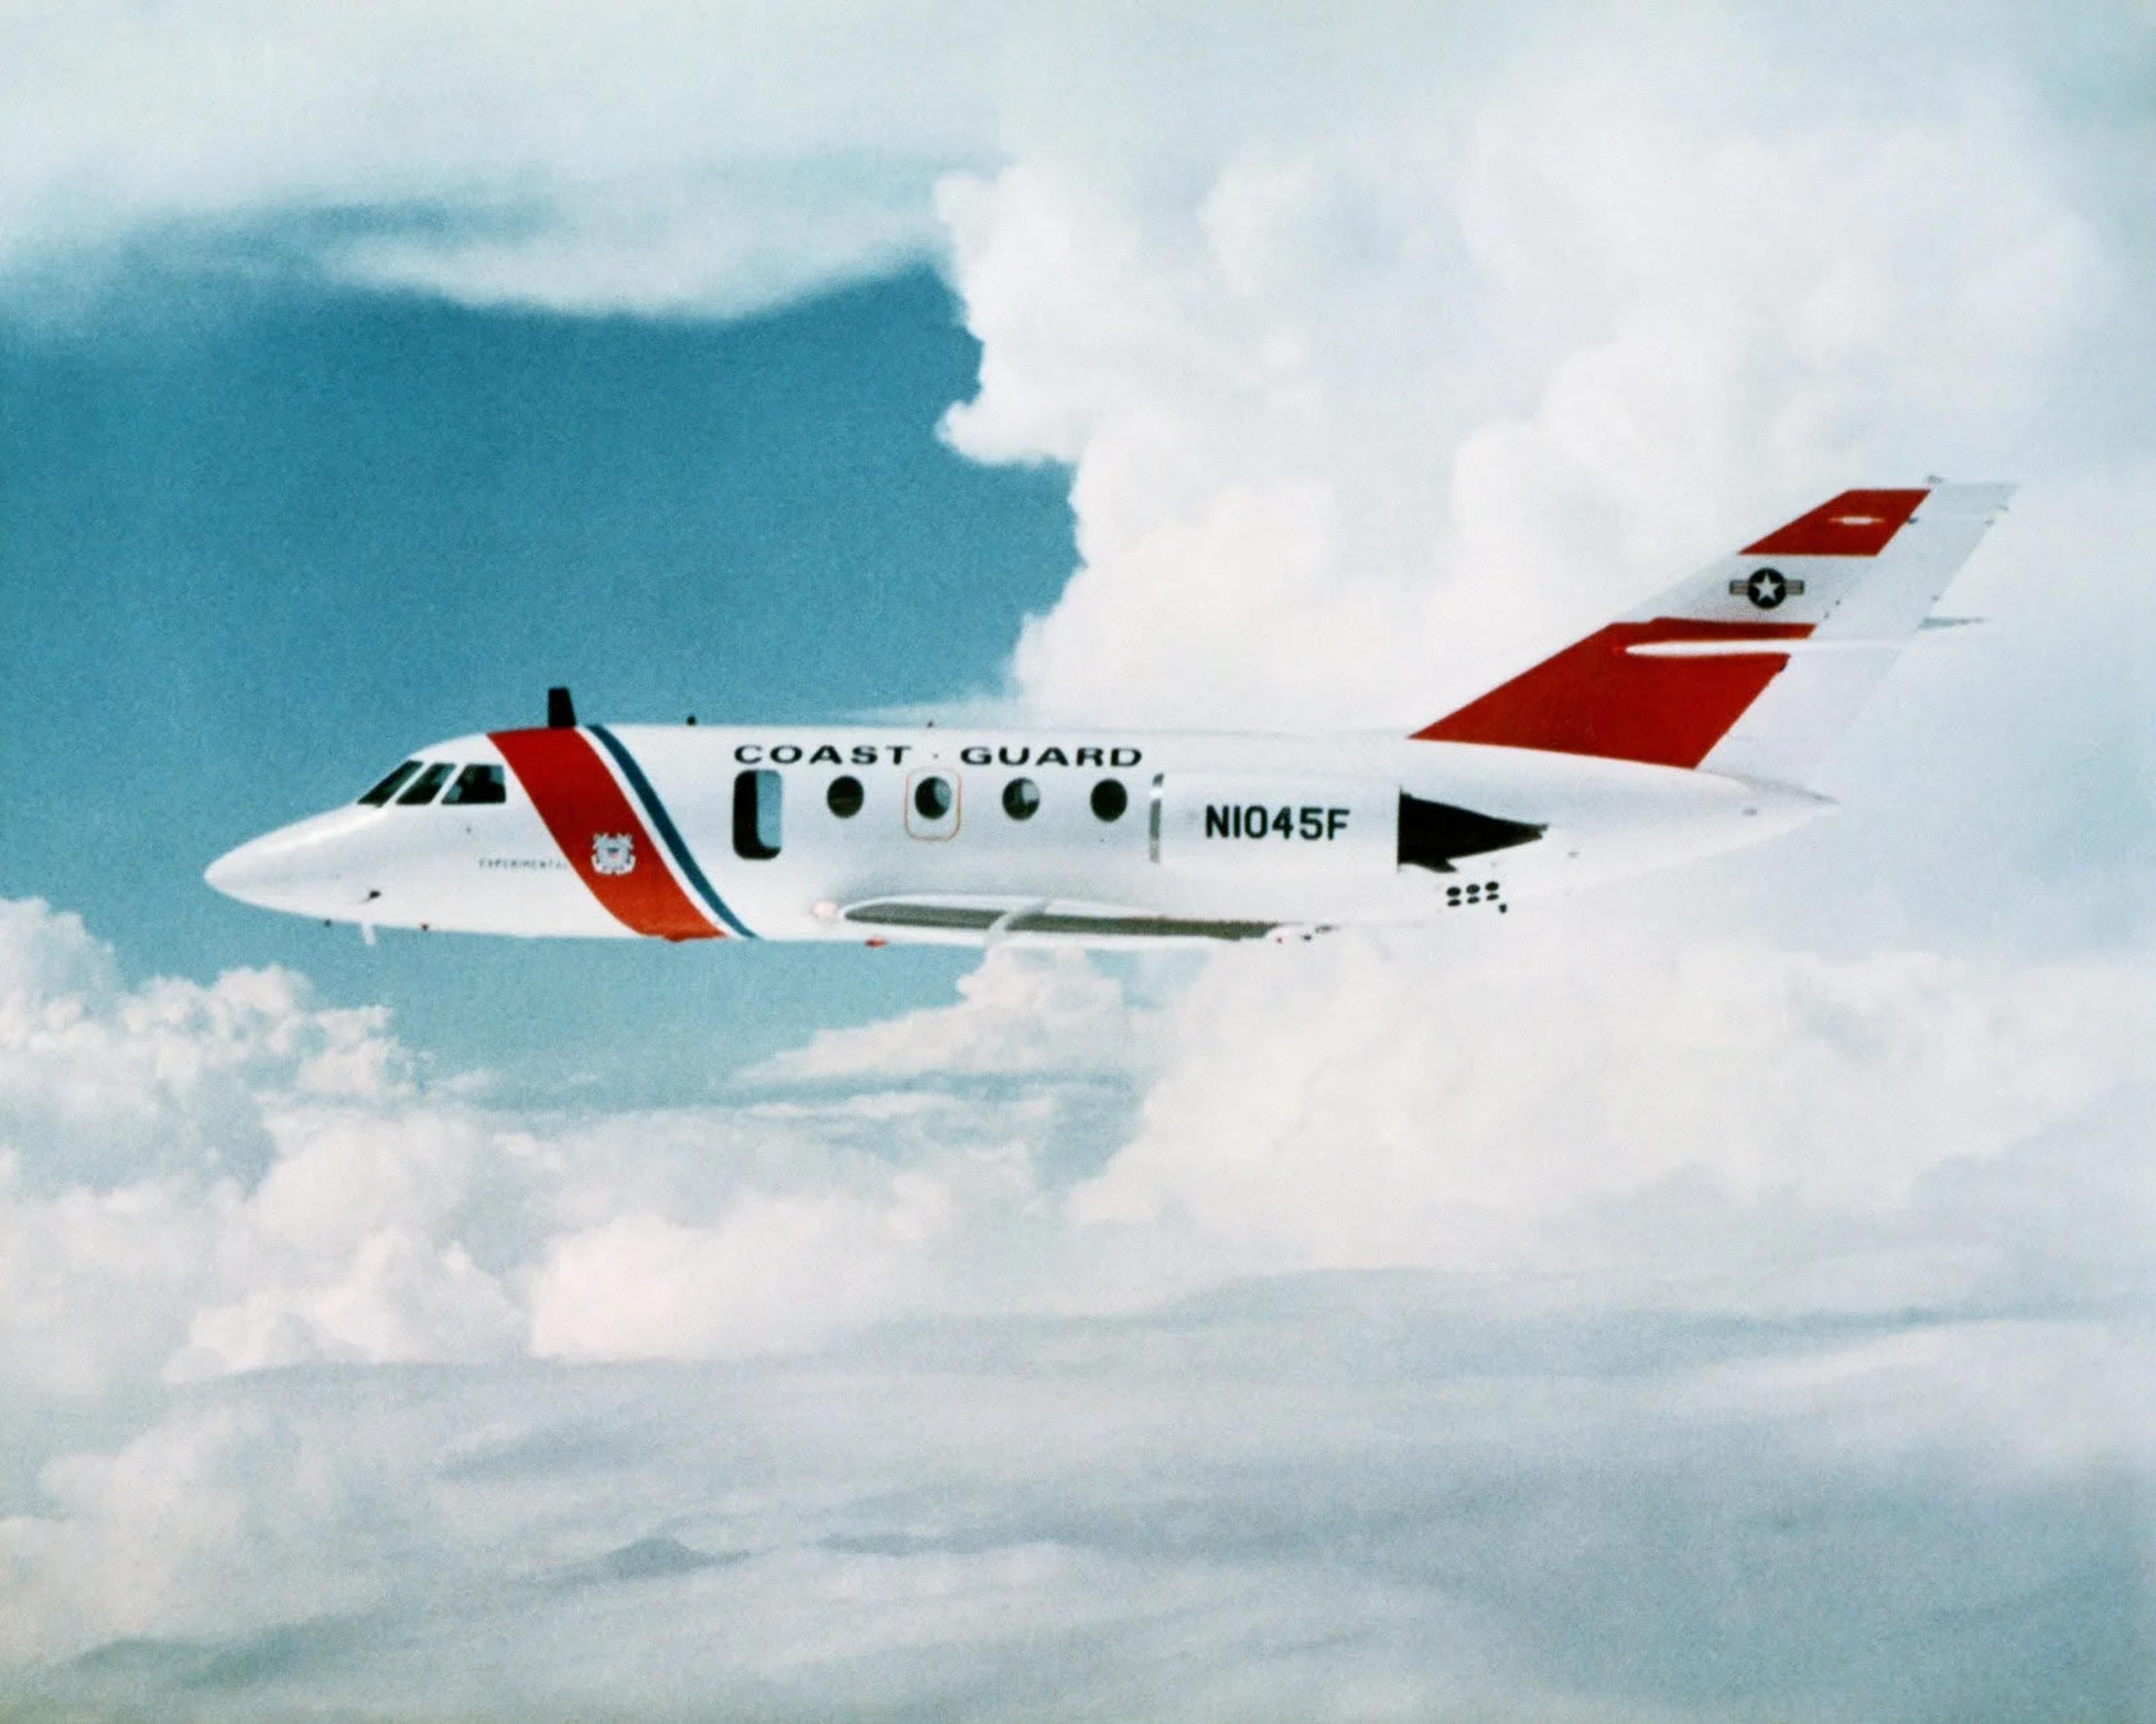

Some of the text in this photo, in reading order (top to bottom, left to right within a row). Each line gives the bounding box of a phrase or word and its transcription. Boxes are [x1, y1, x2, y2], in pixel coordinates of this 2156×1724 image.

[733, 744, 1143, 768] COAST GUARD
[1205, 804, 1350, 841] N1045F
